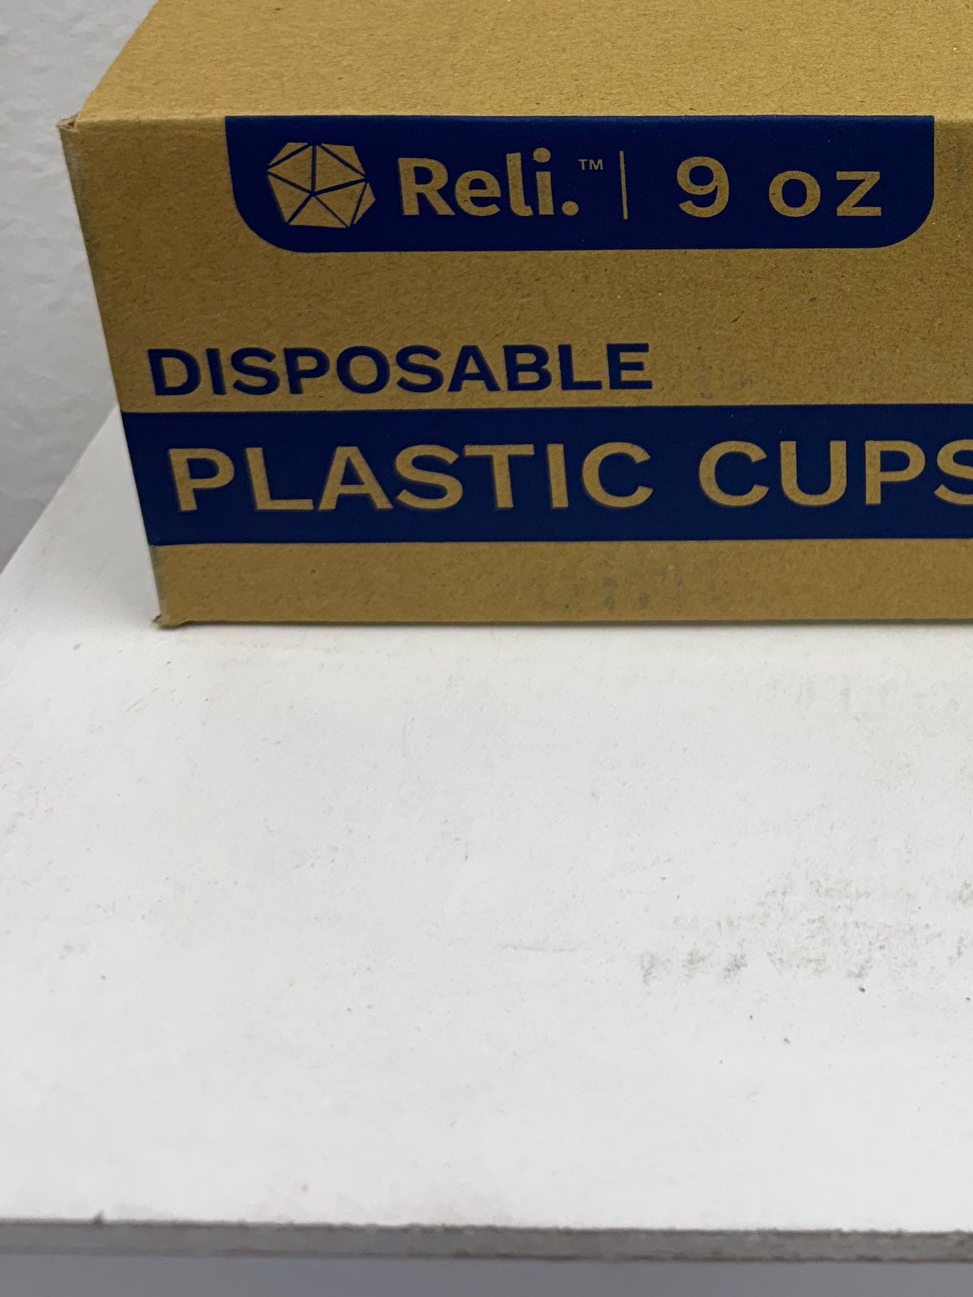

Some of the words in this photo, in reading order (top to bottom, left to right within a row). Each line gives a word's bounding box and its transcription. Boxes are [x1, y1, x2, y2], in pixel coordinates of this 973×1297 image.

[676, 155, 730, 219] 9
[768, 169, 883, 218] oz
[146, 342, 654, 397] DISPOSABLE
[166, 441, 655, 513] PLASTIC
